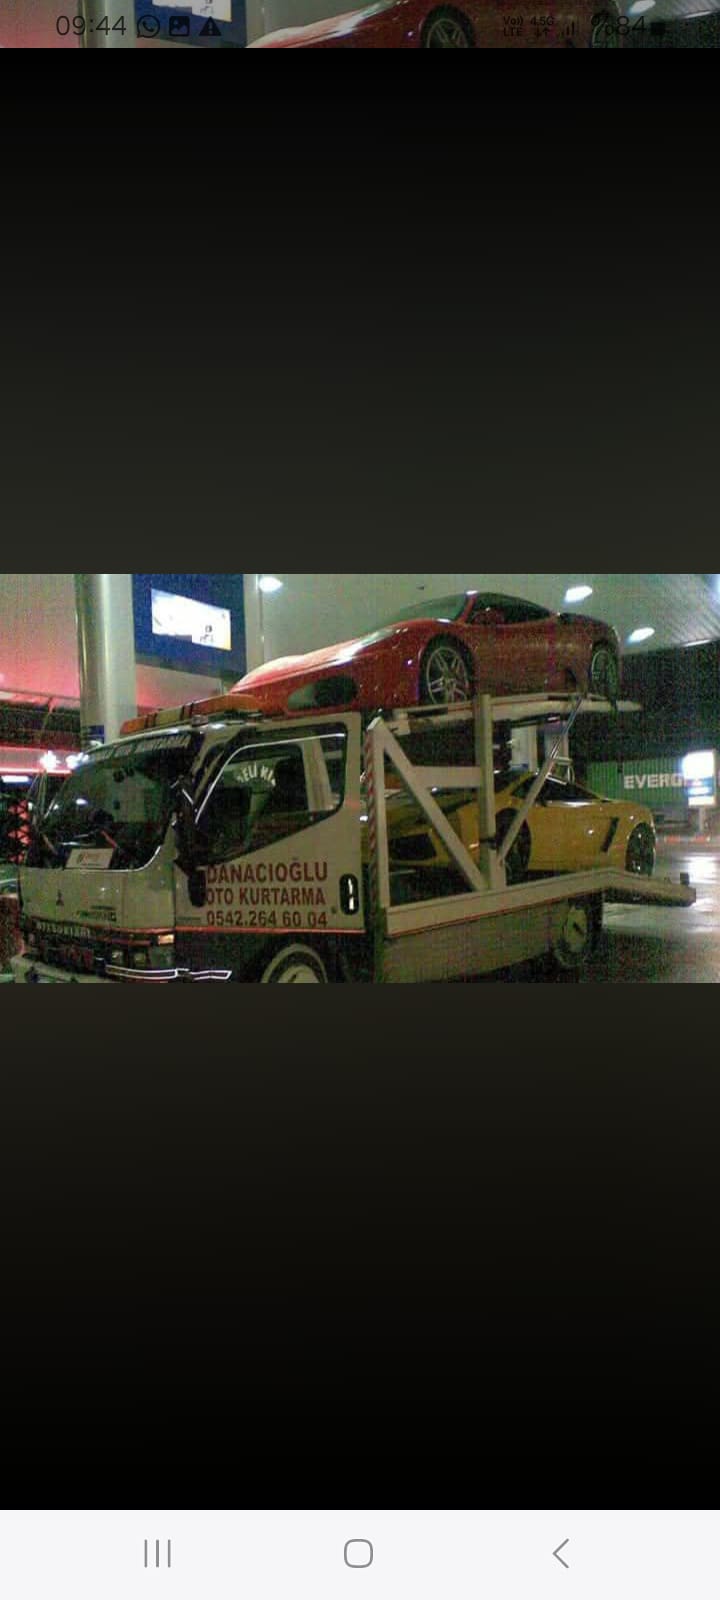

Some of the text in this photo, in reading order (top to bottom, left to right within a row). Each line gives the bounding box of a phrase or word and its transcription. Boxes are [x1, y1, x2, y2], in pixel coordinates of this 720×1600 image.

[623, 773, 688, 789] EVERG
[206, 887, 327, 905] OTO KURTARMA
[282, 911, 302, 927] 60
[307, 911, 328, 927] 04
